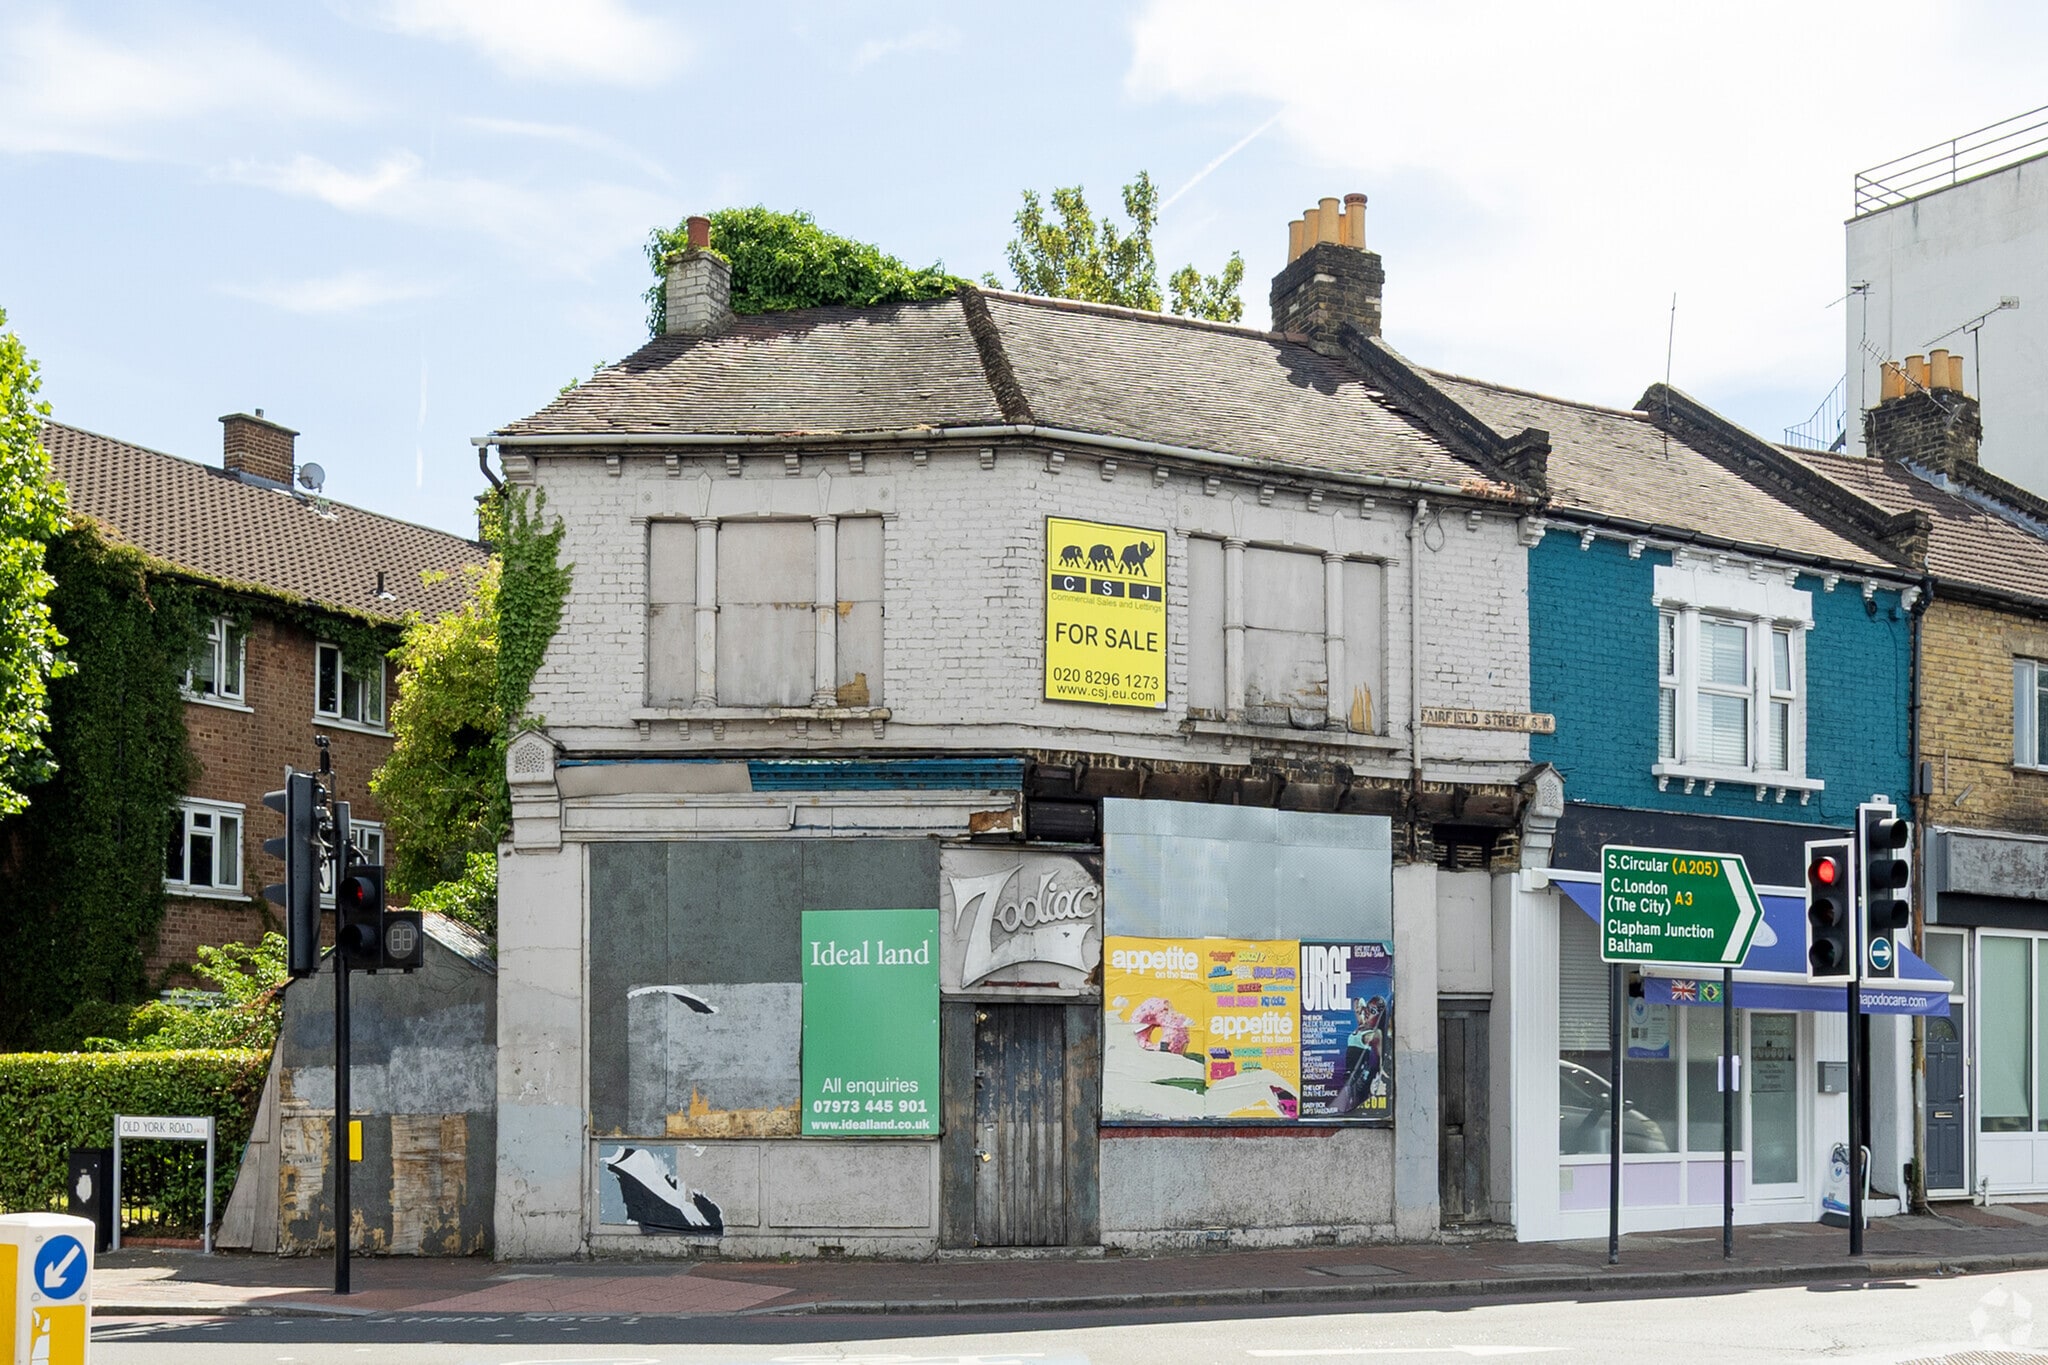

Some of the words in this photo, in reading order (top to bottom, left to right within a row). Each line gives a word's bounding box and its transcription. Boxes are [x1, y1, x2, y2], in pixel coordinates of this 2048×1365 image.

[1051, 592, 1095, 606] Commercial
[1096, 597, 1117, 608] Sales
[1119, 598, 1132, 609] and
[1135, 601, 1162, 614] Lettings
[1056, 622, 1098, 646] FOR
[1105, 627, 1158, 652] SALE
[1053, 667, 1081, 682] 020
[1085, 669, 1120, 686] 8296
[1125, 674, 1159, 689] 1273
[1057, 685, 1155, 702] www.csj.eu.com
[1421, 709, 1479, 725] FAIRFIELD
[1484, 714, 1526, 727] STREET
[1608, 854, 1669, 873] S.Circular
[1672, 857, 1719, 877] (A205)
[1611, 877, 1668, 895] C.London
[1608, 894, 1636, 913] (The
[1640, 897, 1671, 916] City)
[1675, 891, 1693, 906] A3
[949, 864, 1098, 989] Zodiac
[1608, 919, 1661, 937] Clapham
[1664, 922, 1714, 939] Junction
[810, 940, 870, 966] Ideal
[877, 939, 930, 965] land
[1608, 938, 1653, 953] Balham
[1112, 946, 1199, 975] appetite
[1155, 970, 1166, 979] on
[1166, 970, 1179, 979] the
[1180, 970, 1198, 980] farm
[1301, 945, 1351, 1011] URGE
[1251, 1035, 1260, 1043] on
[1262, 1035, 1274, 1043] the
[1275, 1035, 1293, 1043] farm
[822, 1077, 842, 1093] All
[846, 1078, 919, 1097] enquiries
[813, 1099, 861, 1114] 07973
[864, 1099, 894, 1114] 445
[898, 1099, 927, 1114] 901
[123, 1121, 140, 1132] OLD
[143, 1122, 166, 1133] YORK
[169, 1122, 194, 1134] ROAD
[811, 1118, 930, 1131] www.idealland.co.uk
